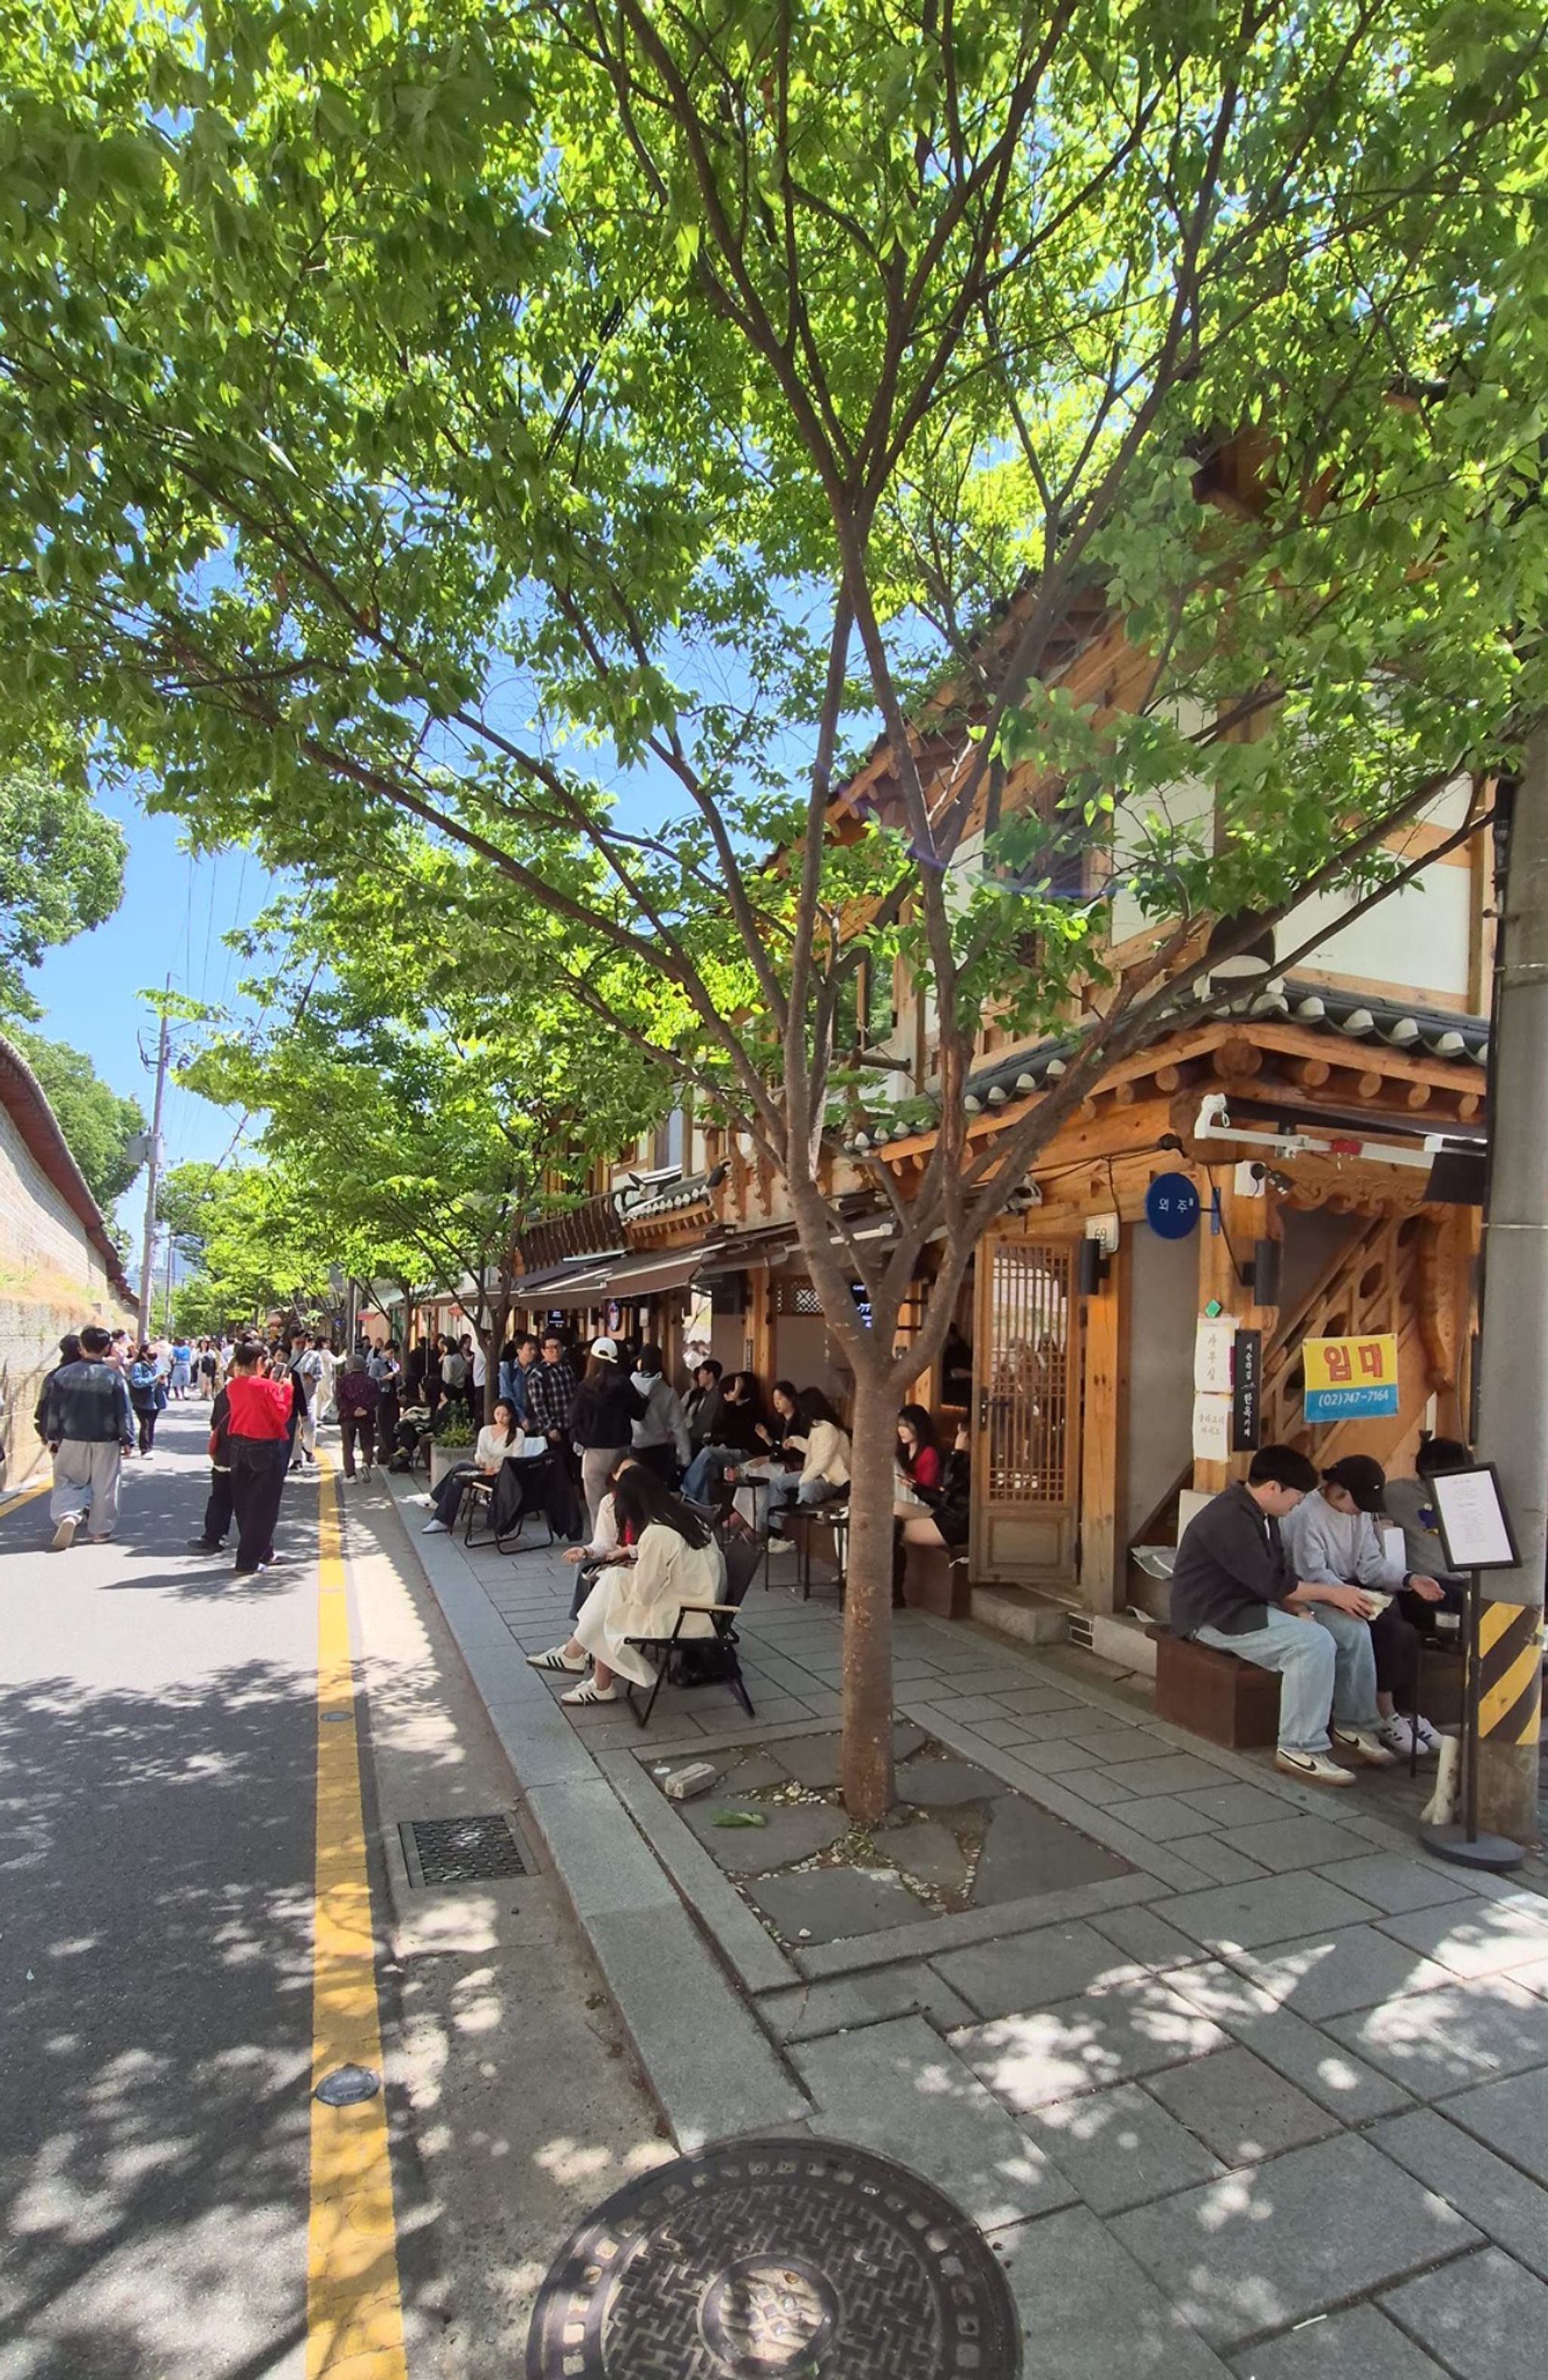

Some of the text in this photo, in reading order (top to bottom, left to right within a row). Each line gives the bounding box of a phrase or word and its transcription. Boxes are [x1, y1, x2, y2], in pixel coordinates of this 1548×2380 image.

[1206, 1334, 1217, 1381] 사무실
[1323, 1343, 1383, 1382] 임대
[1318, 1389, 1389, 1407] (02)747-7164
